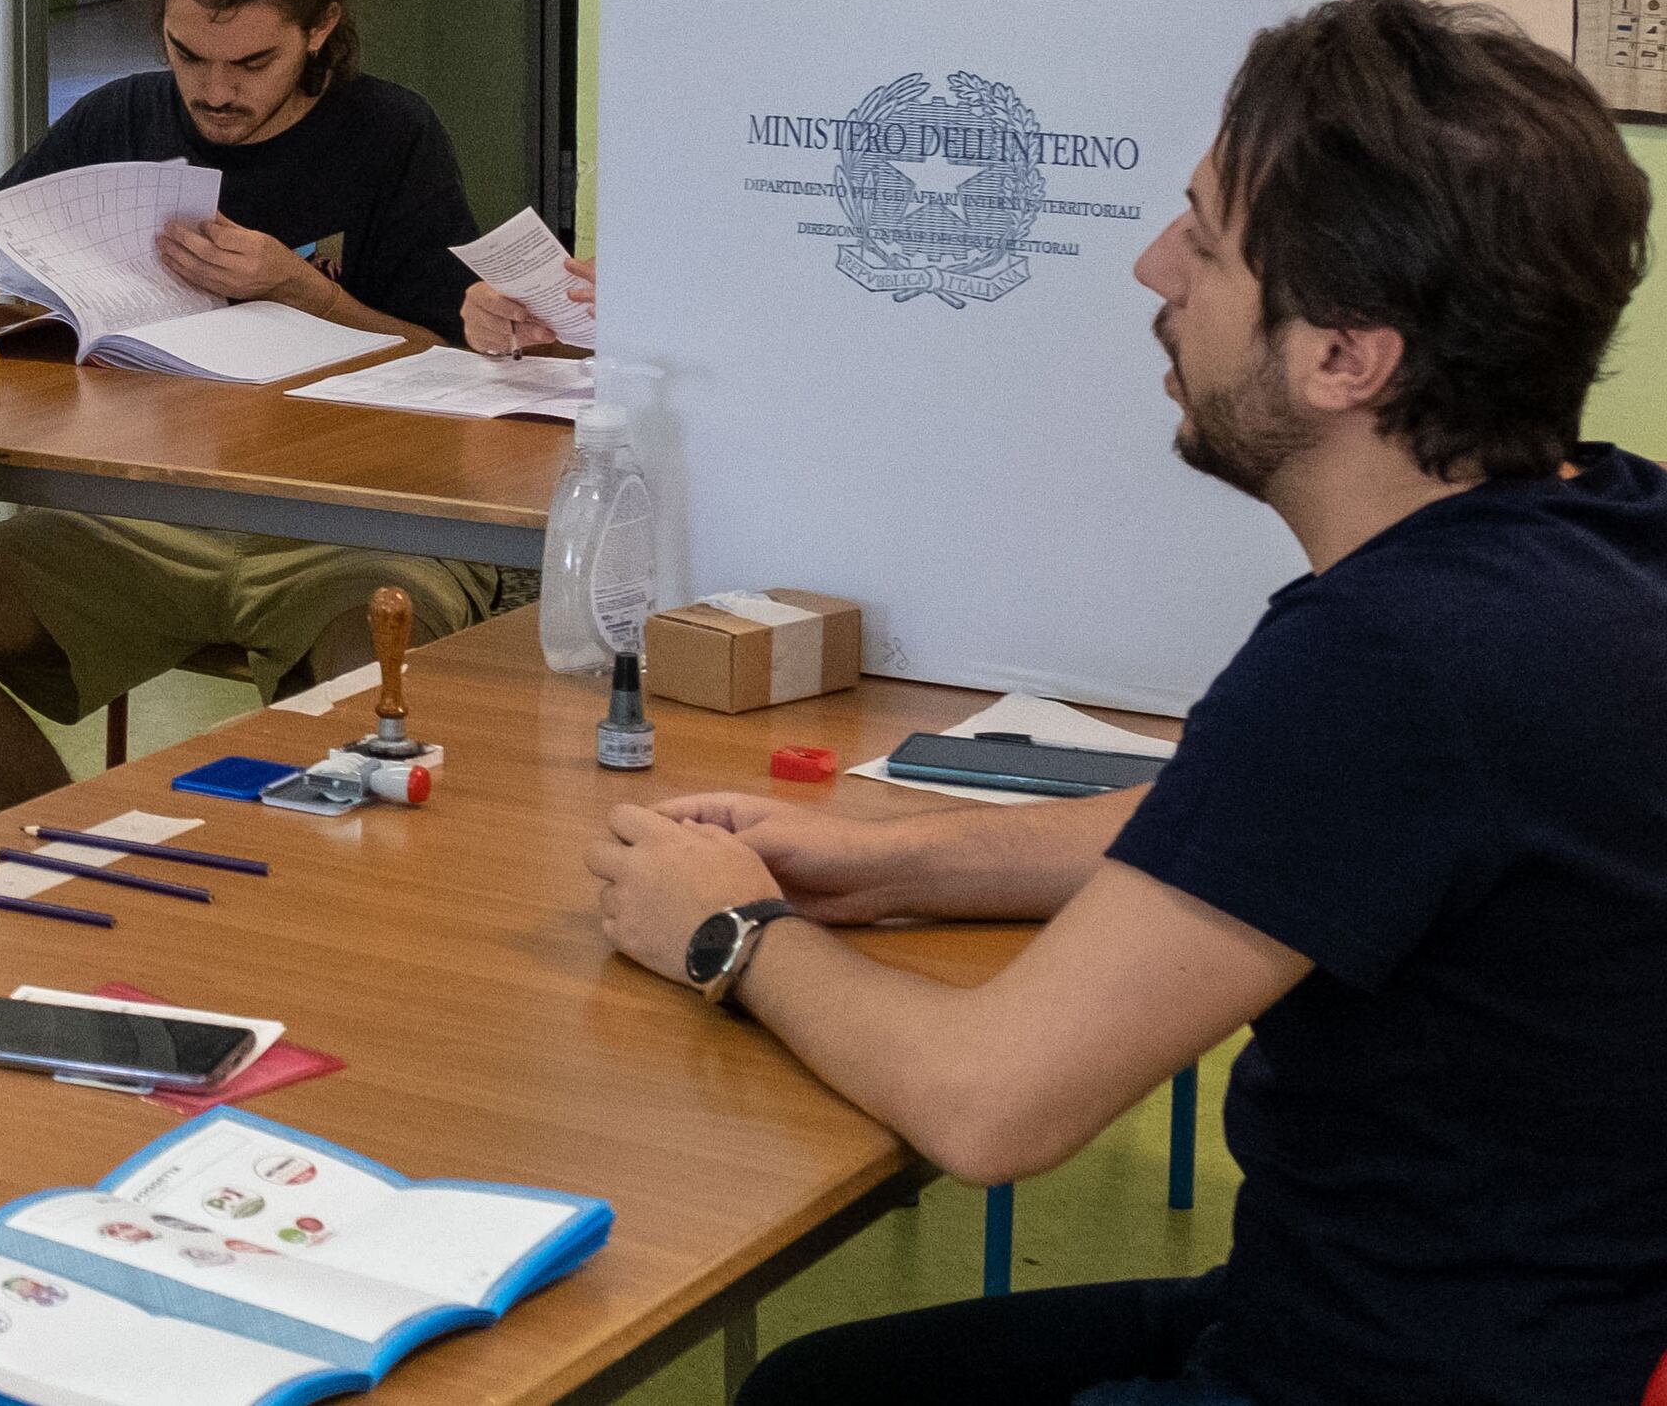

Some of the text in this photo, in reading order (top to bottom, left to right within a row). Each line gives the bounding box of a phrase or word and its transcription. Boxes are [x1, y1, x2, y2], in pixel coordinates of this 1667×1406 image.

[747, 114, 1140, 170] MINISTERO DELL'INTERNO
[743, 177, 848, 199] DIPARTIMENTO
[912, 190, 959, 207] AFFARI
[1041, 199, 1142, 220] TERRITORIALI
[797, 222, 865, 239] DIREZIONE
[1004, 239, 1080, 256] ELETTORALI
[947, 269, 1028, 297] ITALIANA
